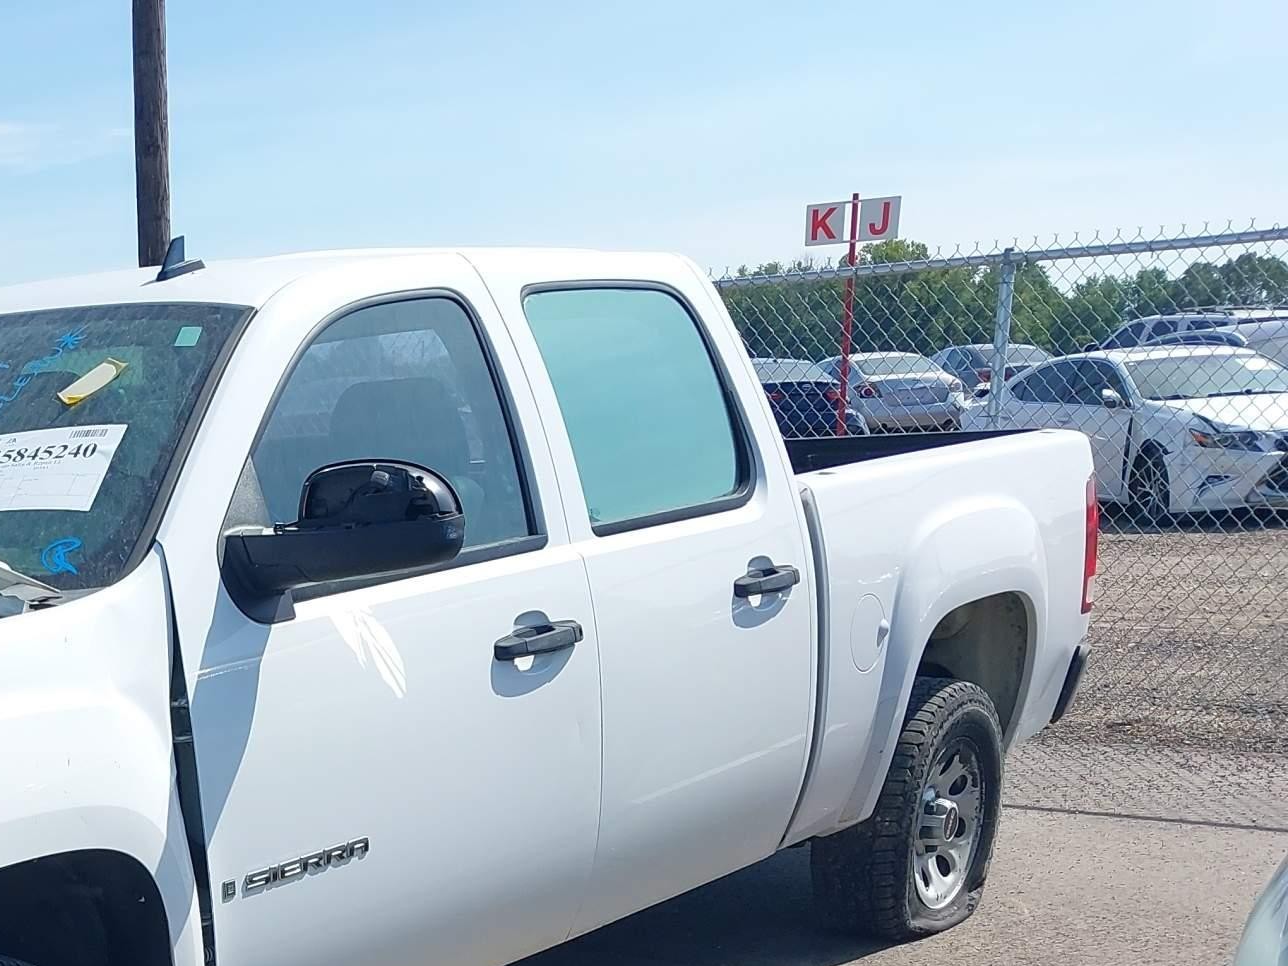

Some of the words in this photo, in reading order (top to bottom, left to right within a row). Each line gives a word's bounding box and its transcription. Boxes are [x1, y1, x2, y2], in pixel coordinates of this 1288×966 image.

[811, 207, 838, 241] K
[868, 201, 891, 236] J
[242, 836, 371, 899] SIERRA
